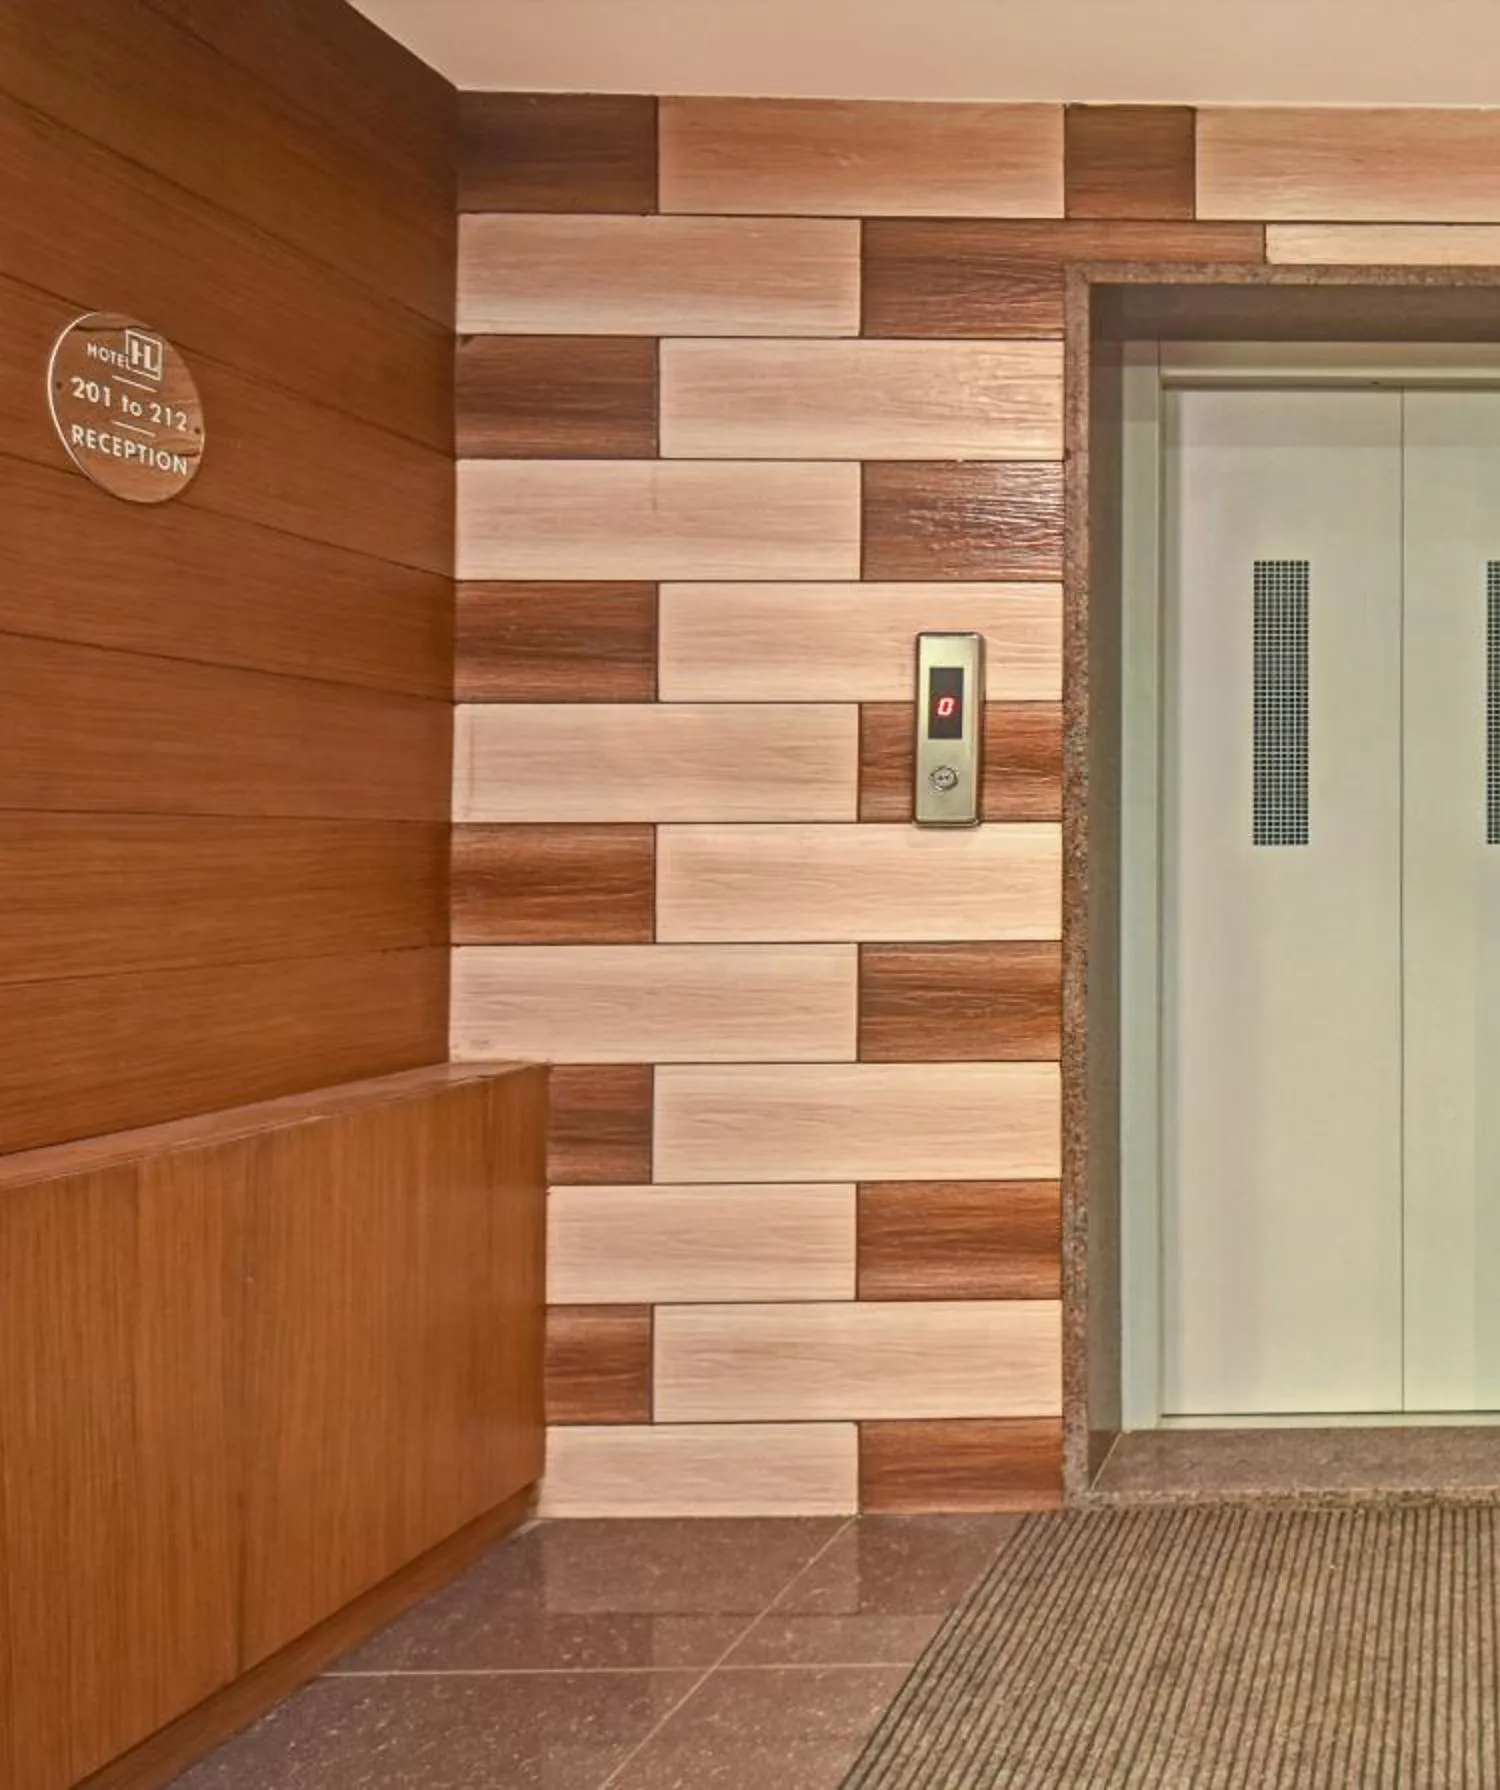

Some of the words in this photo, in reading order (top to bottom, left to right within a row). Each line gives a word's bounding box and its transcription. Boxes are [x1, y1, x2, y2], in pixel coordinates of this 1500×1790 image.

[70, 376, 111, 407] 201
[121, 394, 142, 417] to
[149, 403, 188, 432] 212
[71, 424, 188, 476] RECEPTION
